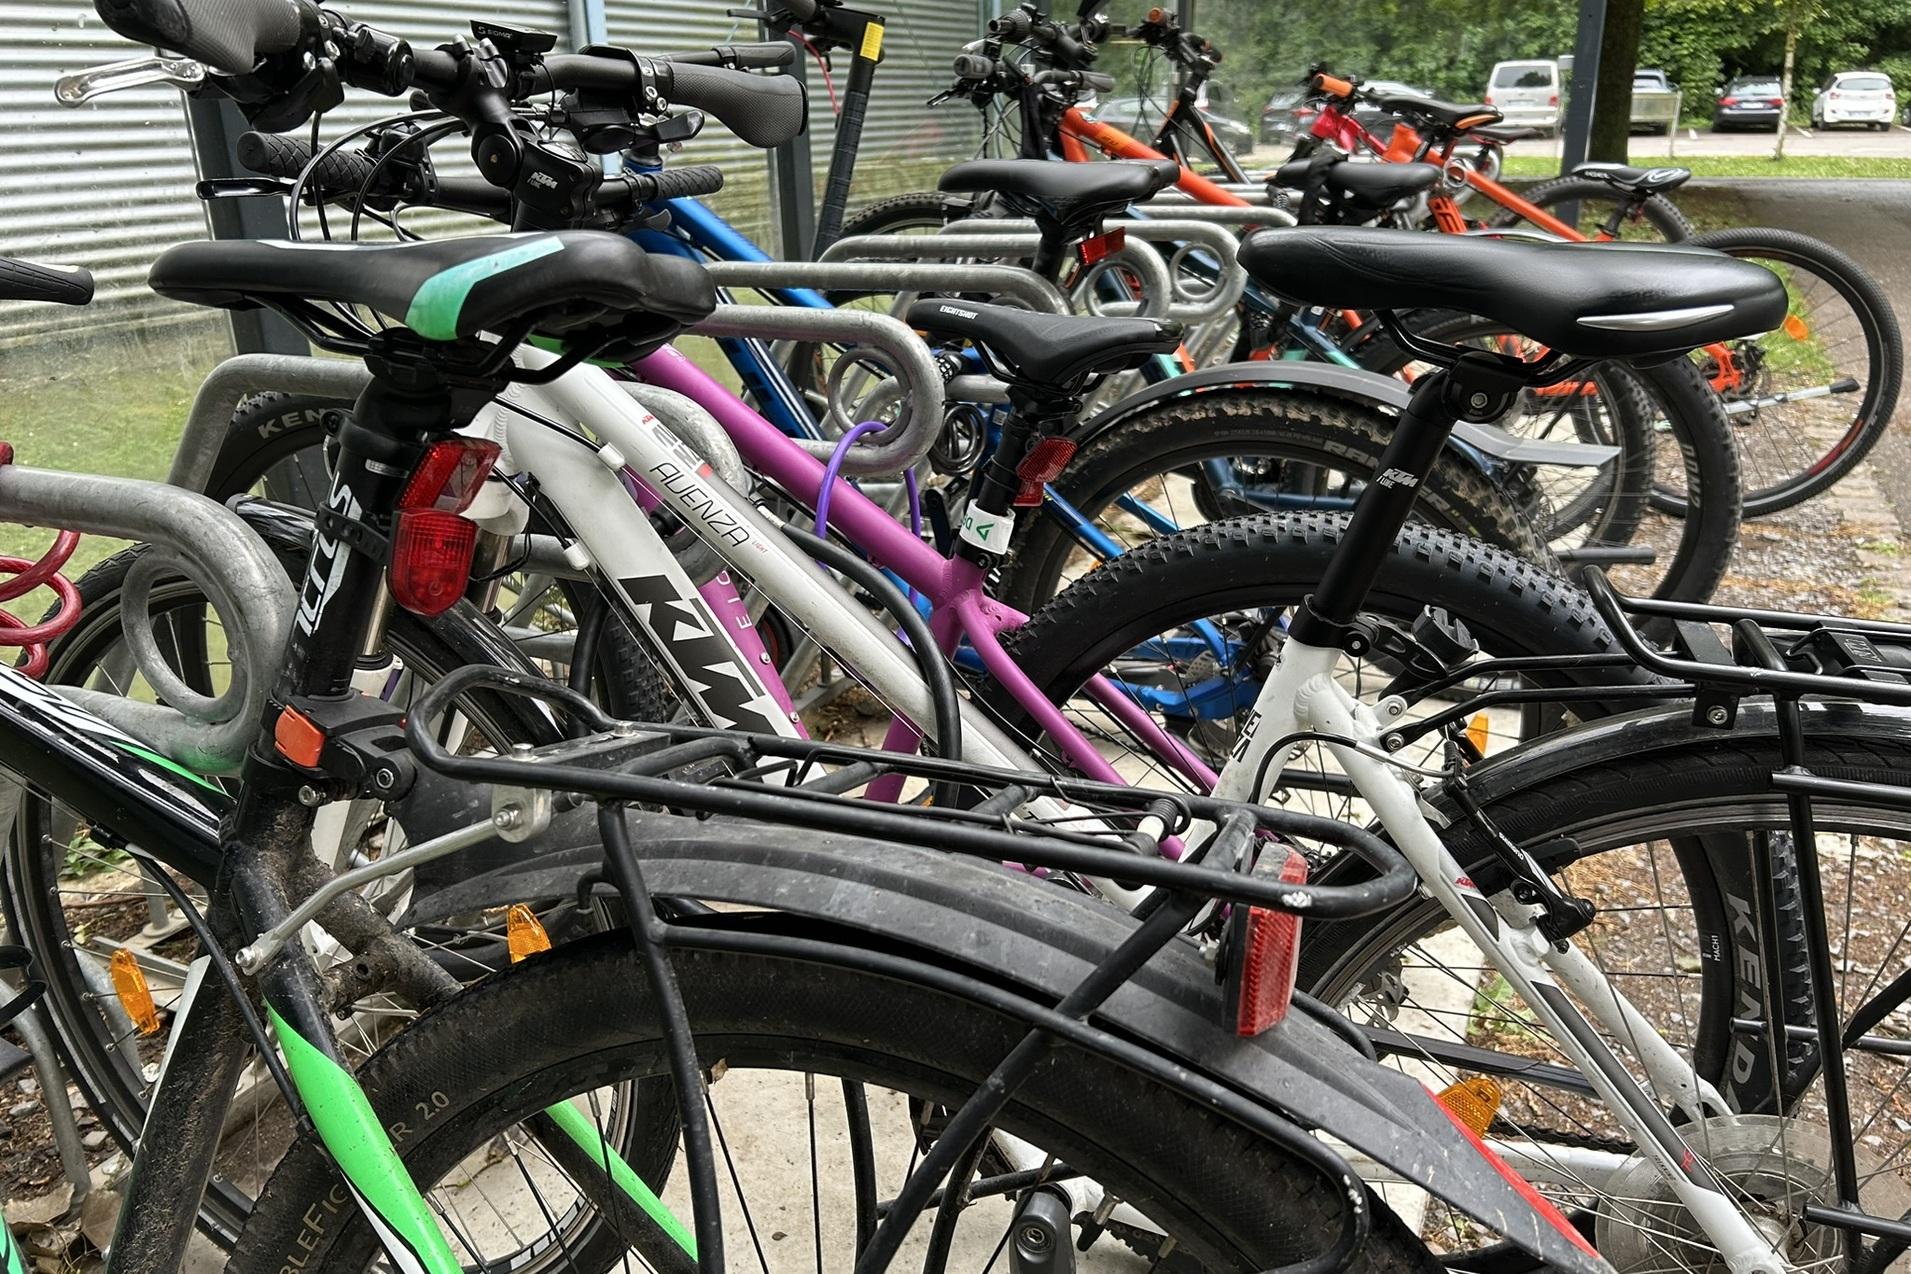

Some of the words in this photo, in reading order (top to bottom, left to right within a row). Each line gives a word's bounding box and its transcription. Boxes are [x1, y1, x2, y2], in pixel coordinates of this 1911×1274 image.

[257, 407, 328, 440] KEN
[1383, 467, 1419, 489] KTM
[616, 573, 782, 737] KTM
[414, 1090, 451, 1120] 2.0
